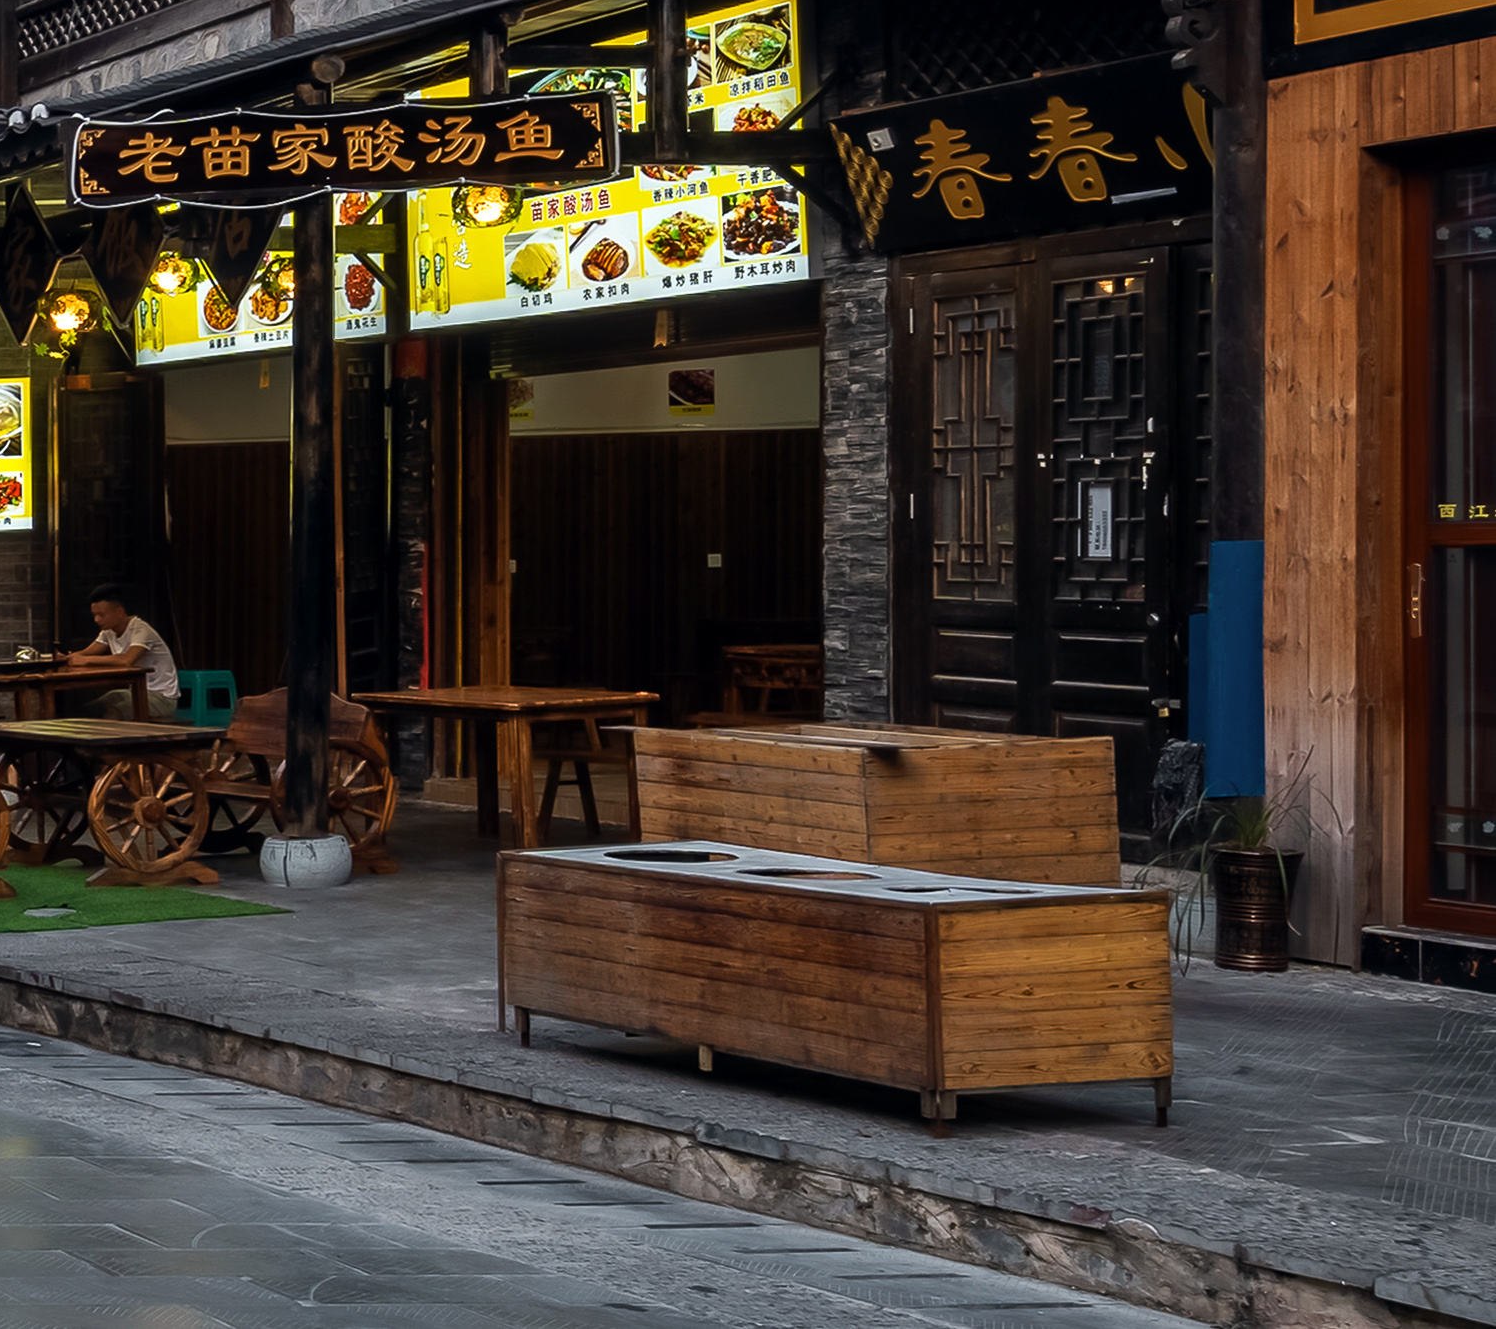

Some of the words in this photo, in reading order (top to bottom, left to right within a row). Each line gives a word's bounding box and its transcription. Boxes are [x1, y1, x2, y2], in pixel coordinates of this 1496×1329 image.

[729, 71, 791, 98] 凉拌稻田鱼
[118, 111, 565, 182] 老苗家酸汤鱼
[653, 181, 710, 203] 香辣小河鱼
[530, 189, 612, 222] 苗家酸汤鱼
[662, 270, 714, 290] 爆炒猪肝
[734, 260, 797, 280] 野木耳炒肉
[521, 293, 553, 308] 白切鸡
[583, 283, 630, 301] 农家扣肉
[1438, 504, 1496, 519] 西江
